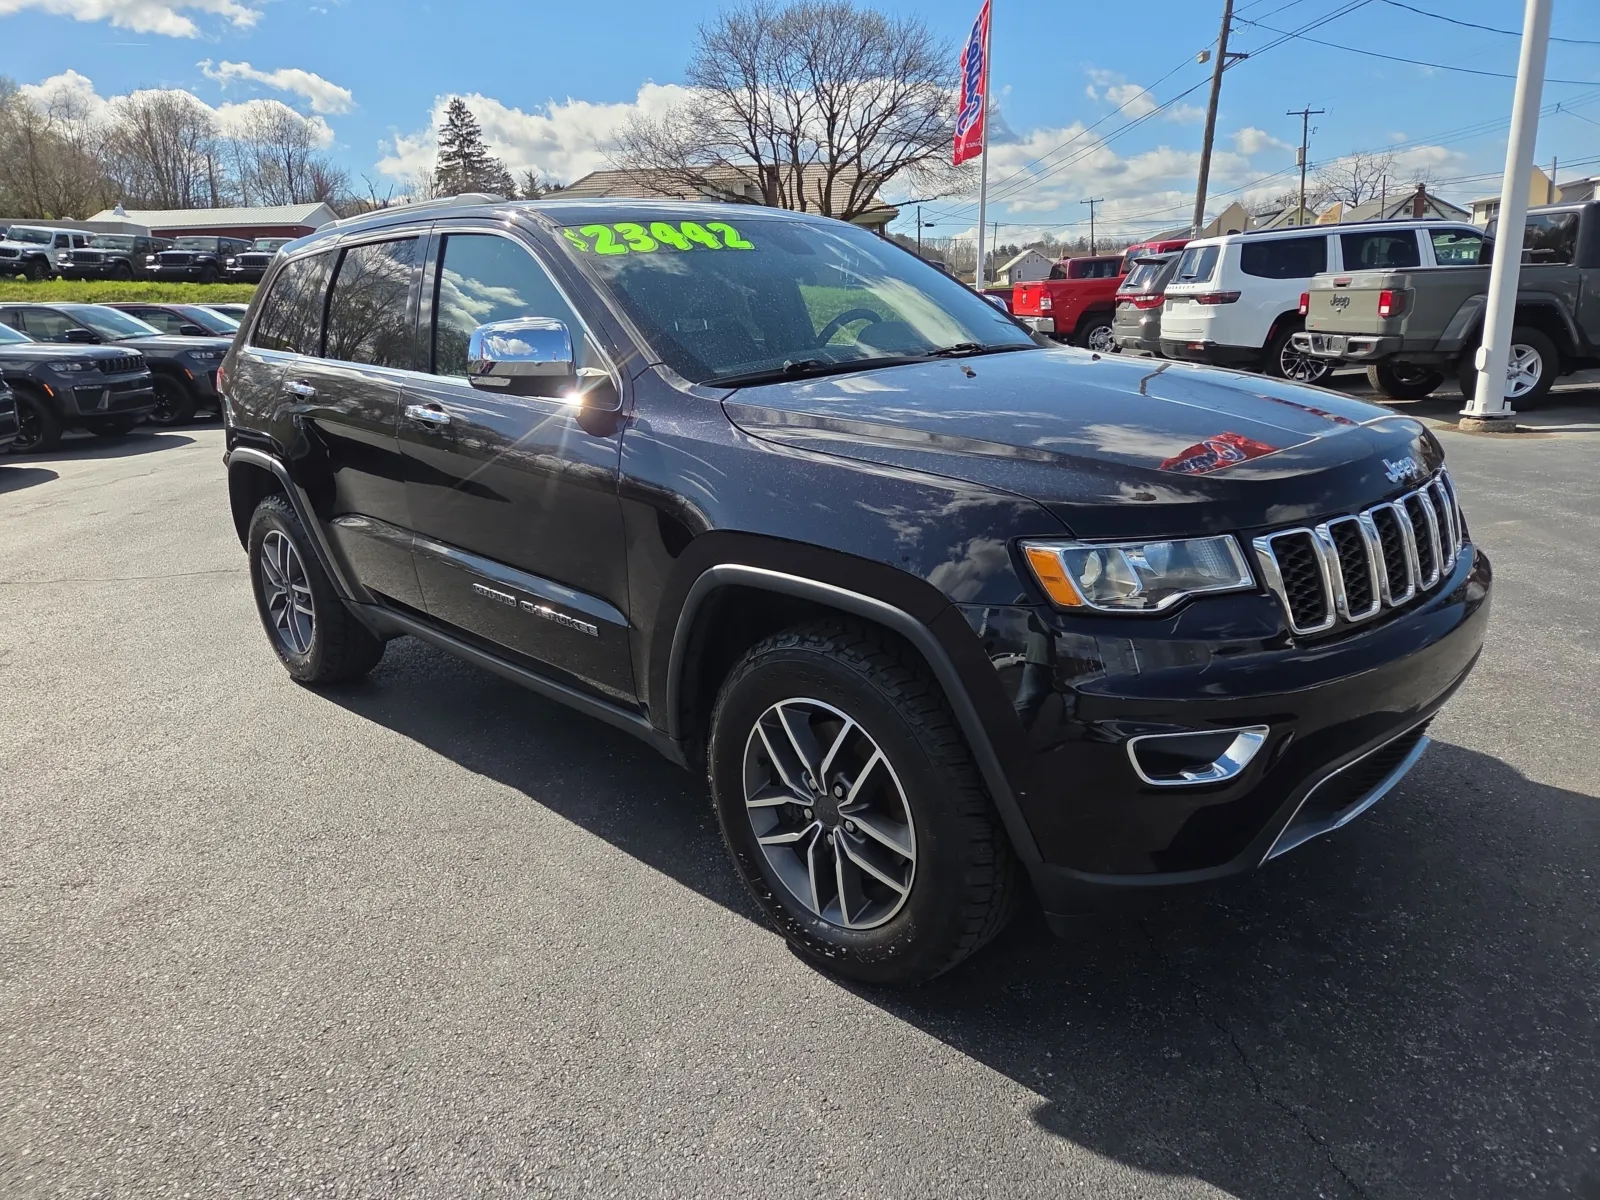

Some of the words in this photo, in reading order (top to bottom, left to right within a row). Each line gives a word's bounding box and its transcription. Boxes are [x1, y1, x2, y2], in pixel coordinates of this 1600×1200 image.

[563, 221, 756, 255] $23442
[1329, 293, 1351, 309] Jeep
[1382, 456, 1418, 483] Jeep
[472, 582, 518, 608] GRAND
[519, 599, 600, 638] CHEROKEE
